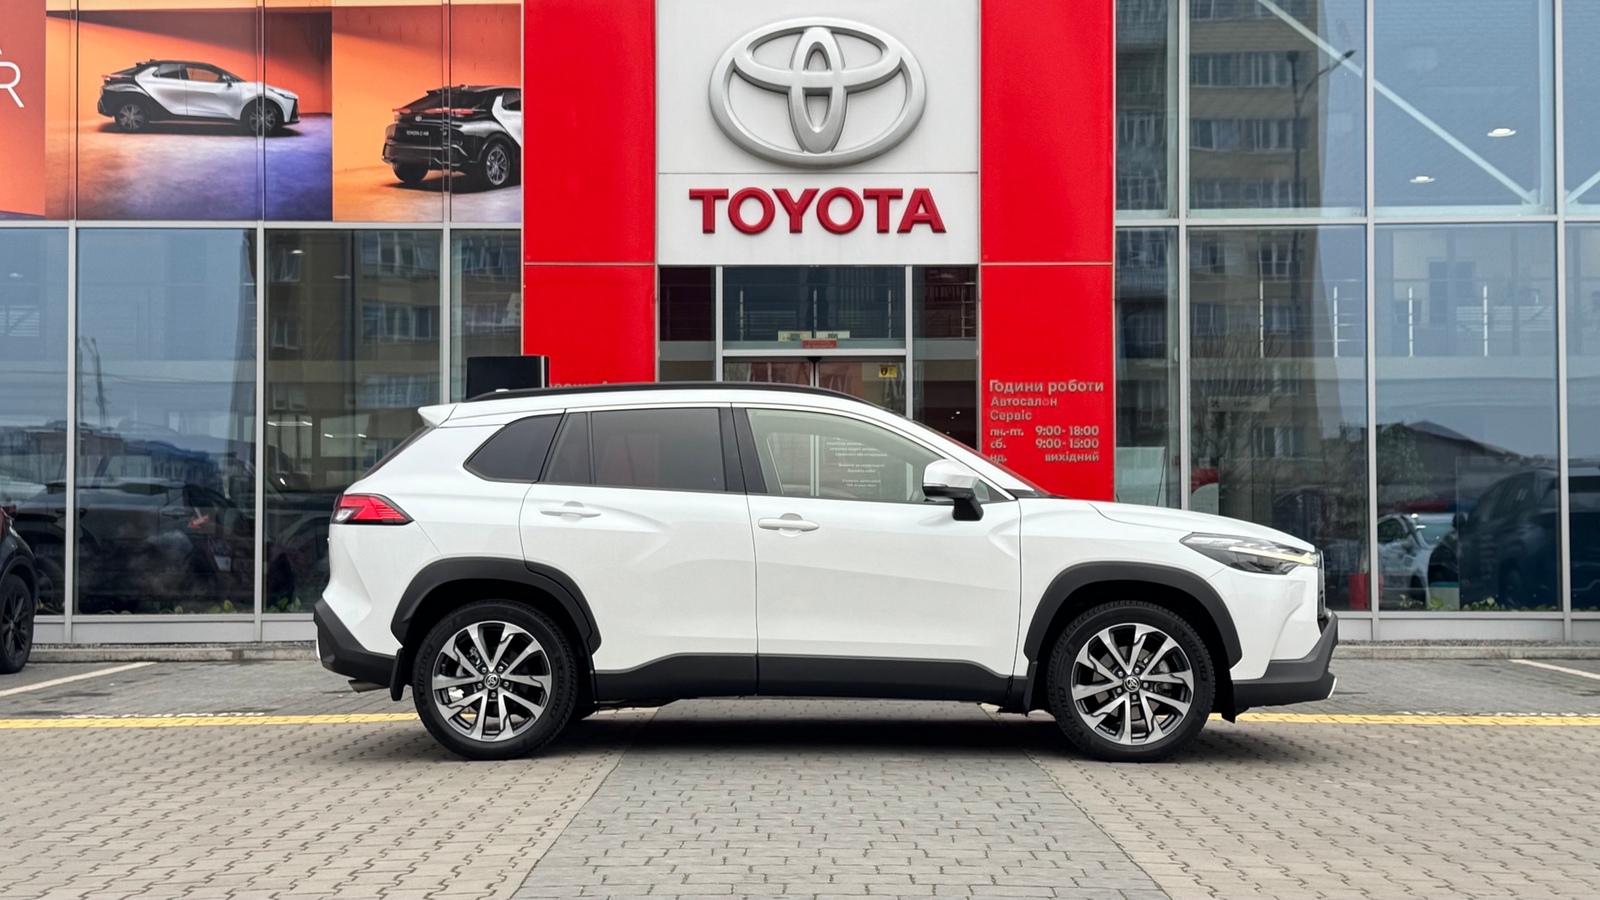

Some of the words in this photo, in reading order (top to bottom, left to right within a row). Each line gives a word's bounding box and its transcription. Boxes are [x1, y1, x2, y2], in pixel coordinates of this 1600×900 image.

[689, 187, 947, 235] TOYOTA
[989, 380, 1043, 394] Години
[1048, 379, 1104, 395] роботи
[990, 397, 1058, 407] Автосалон
[990, 410, 1032, 422] Сервіс
[990, 438, 1006, 449] сб.
[1045, 451, 1099, 463] вихідний
